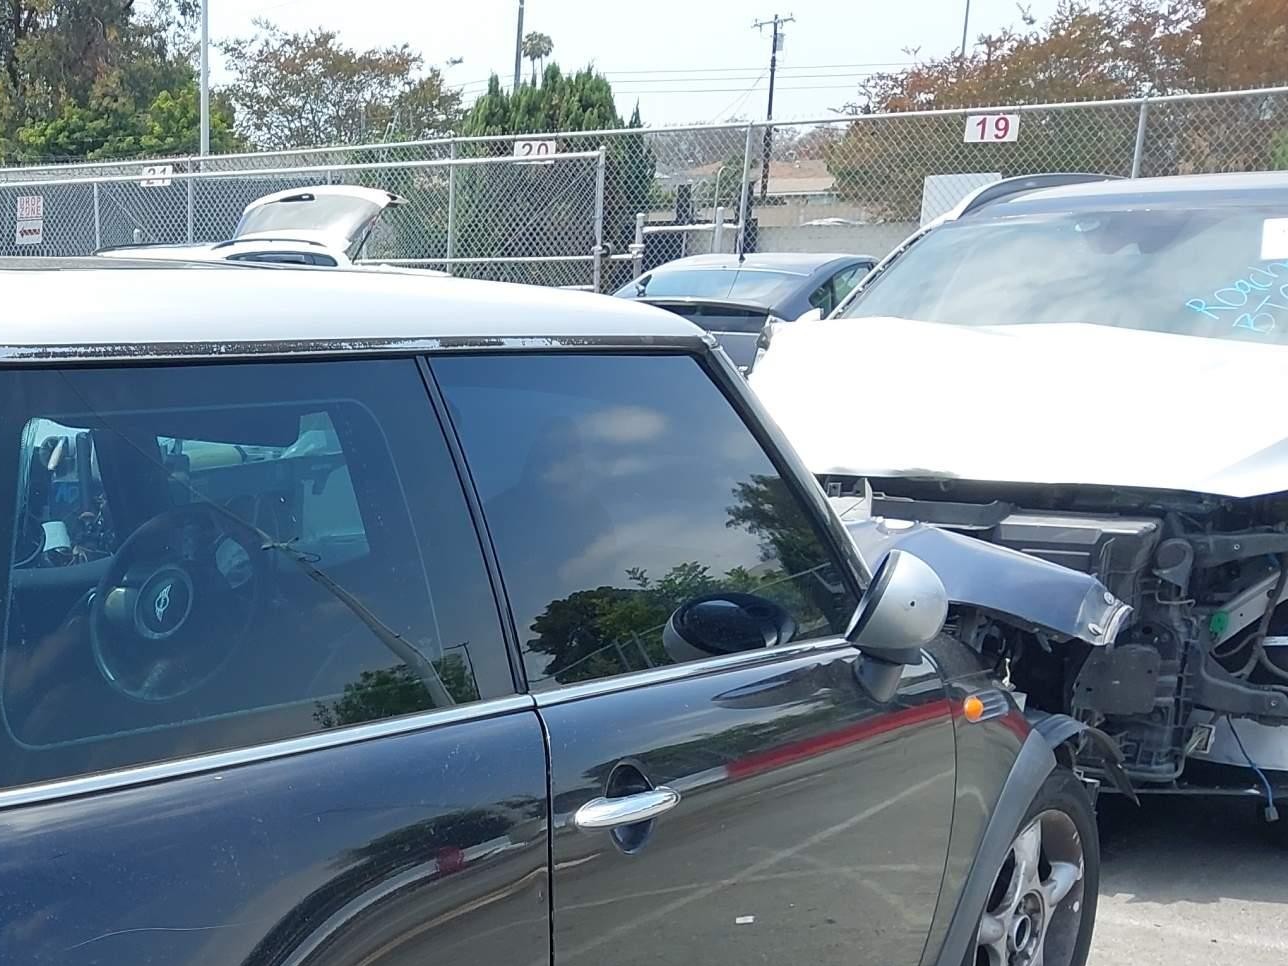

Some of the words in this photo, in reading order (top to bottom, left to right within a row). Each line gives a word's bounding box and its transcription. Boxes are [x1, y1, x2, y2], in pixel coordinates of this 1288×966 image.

[976, 116, 1010, 140] 19
[522, 142, 549, 156] 20
[146, 167, 167, 185] 21
[19, 196, 41, 206] DROP
[19, 205, 41, 216] ZONE
